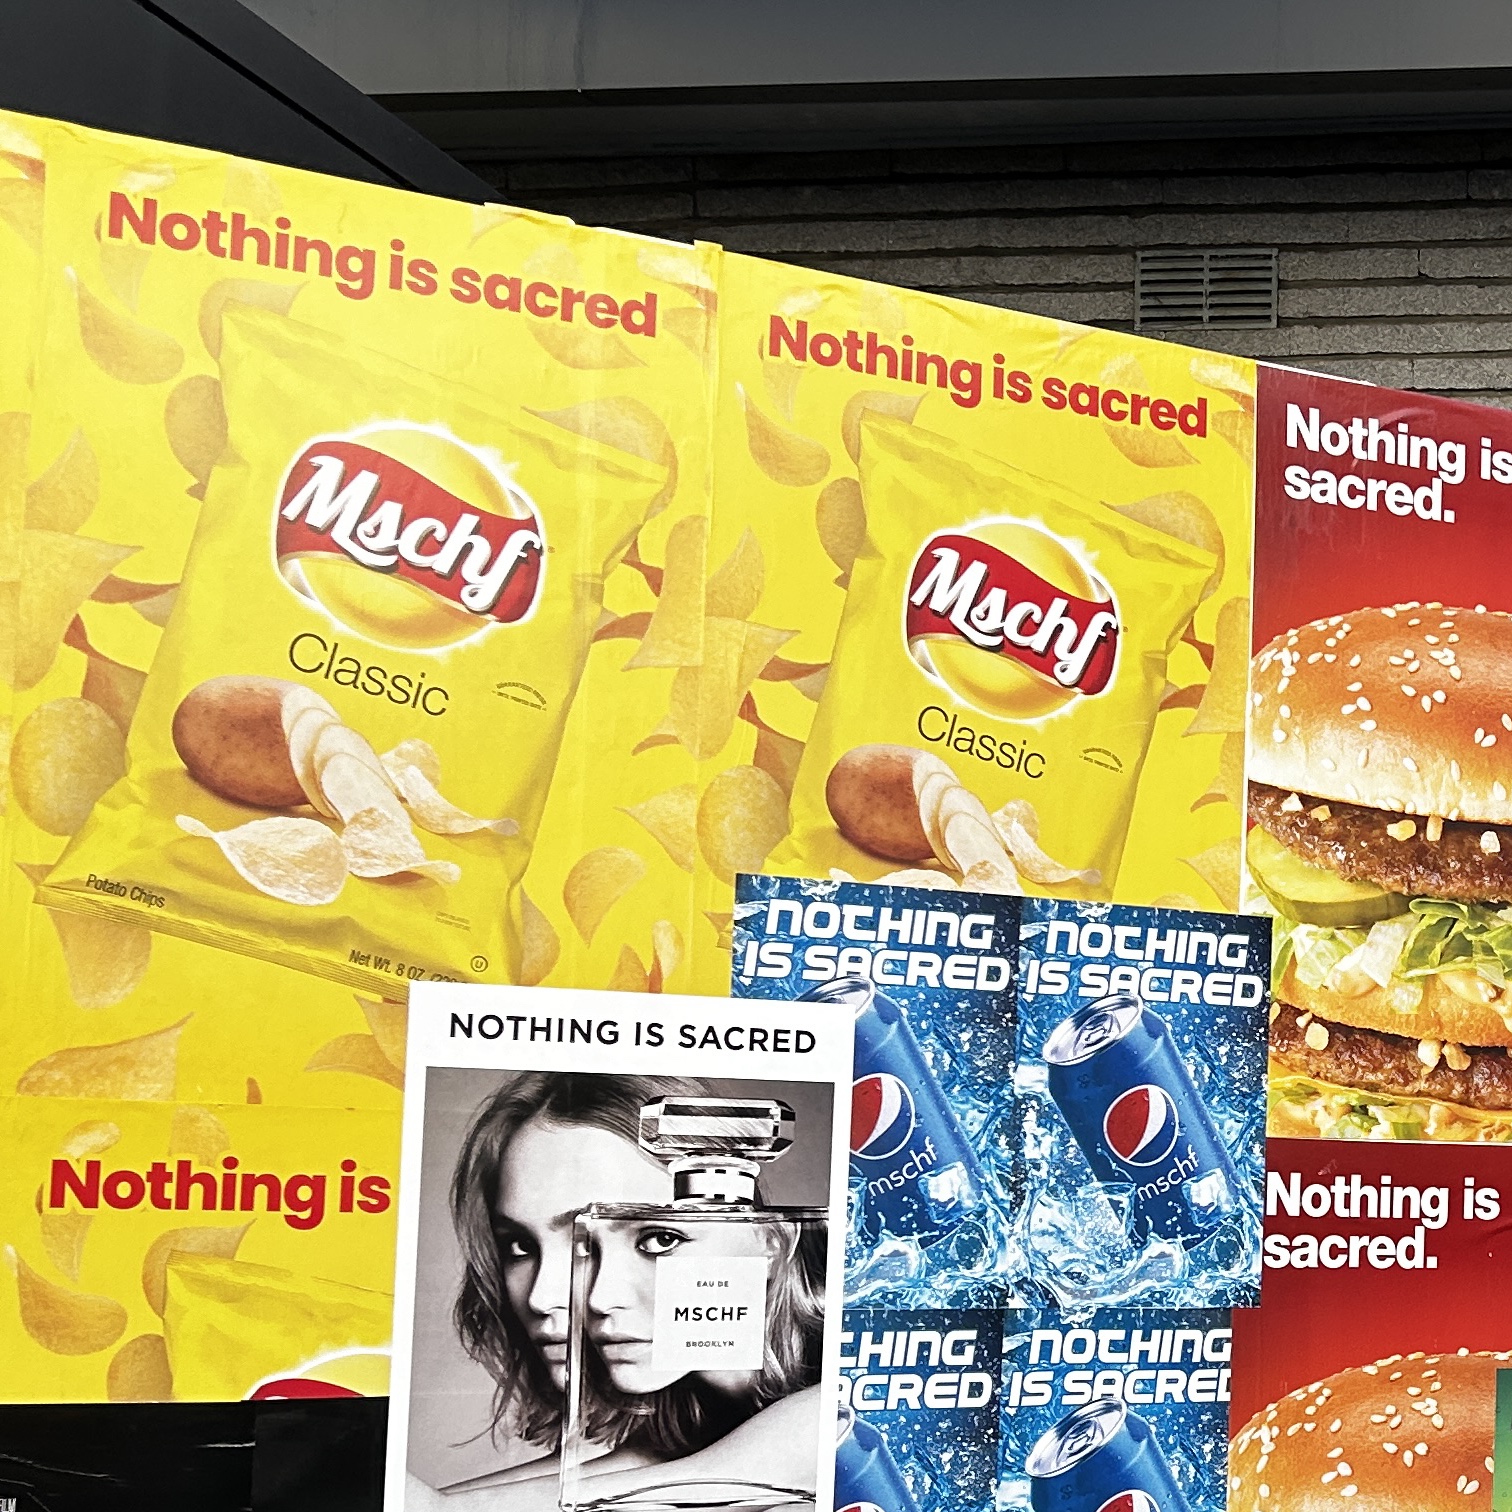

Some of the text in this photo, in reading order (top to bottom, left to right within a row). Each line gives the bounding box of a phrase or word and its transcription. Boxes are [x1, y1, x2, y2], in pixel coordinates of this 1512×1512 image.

[107, 192, 658, 338] Nothing is sacred
[768, 315, 1208, 438] Nothing is sacred
[1285, 403, 1466, 485] Nothing
[1284, 467, 1456, 523] sacred.
[281, 456, 539, 608] Mschf
[910, 548, 1117, 681] Mschf
[287, 632, 450, 717] Classic
[917, 705, 1046, 780] Classic
[85, 873, 166, 909] Potato Chips
[765, 900, 996, 949] NOTHING
[1046, 921, 1250, 967] NOTHING
[349, 949, 370, 967] Net
[395, 963, 405, 977] 8
[742, 943, 1013, 993] IS SACRED
[1024, 960, 1264, 1008] IS SACRED
[450, 1012, 816, 1054] NOTHING IS SACRED
[49, 1156, 391, 1230] Nothing is
[868, 1141, 940, 1198] mschf
[1137, 1143, 1200, 1202] mschf
[1264, 1171, 1500, 1230] Nothing is
[1264, 1226, 1439, 1270] sacred.
[674, 1307, 748, 1321] MSCHF
[840, 1330, 977, 1367] HING
[1028, 1328, 1232, 1365] NOTHING
[838, 1372, 993, 1411] CRED
[1008, 1369, 1051, 1407] IS
